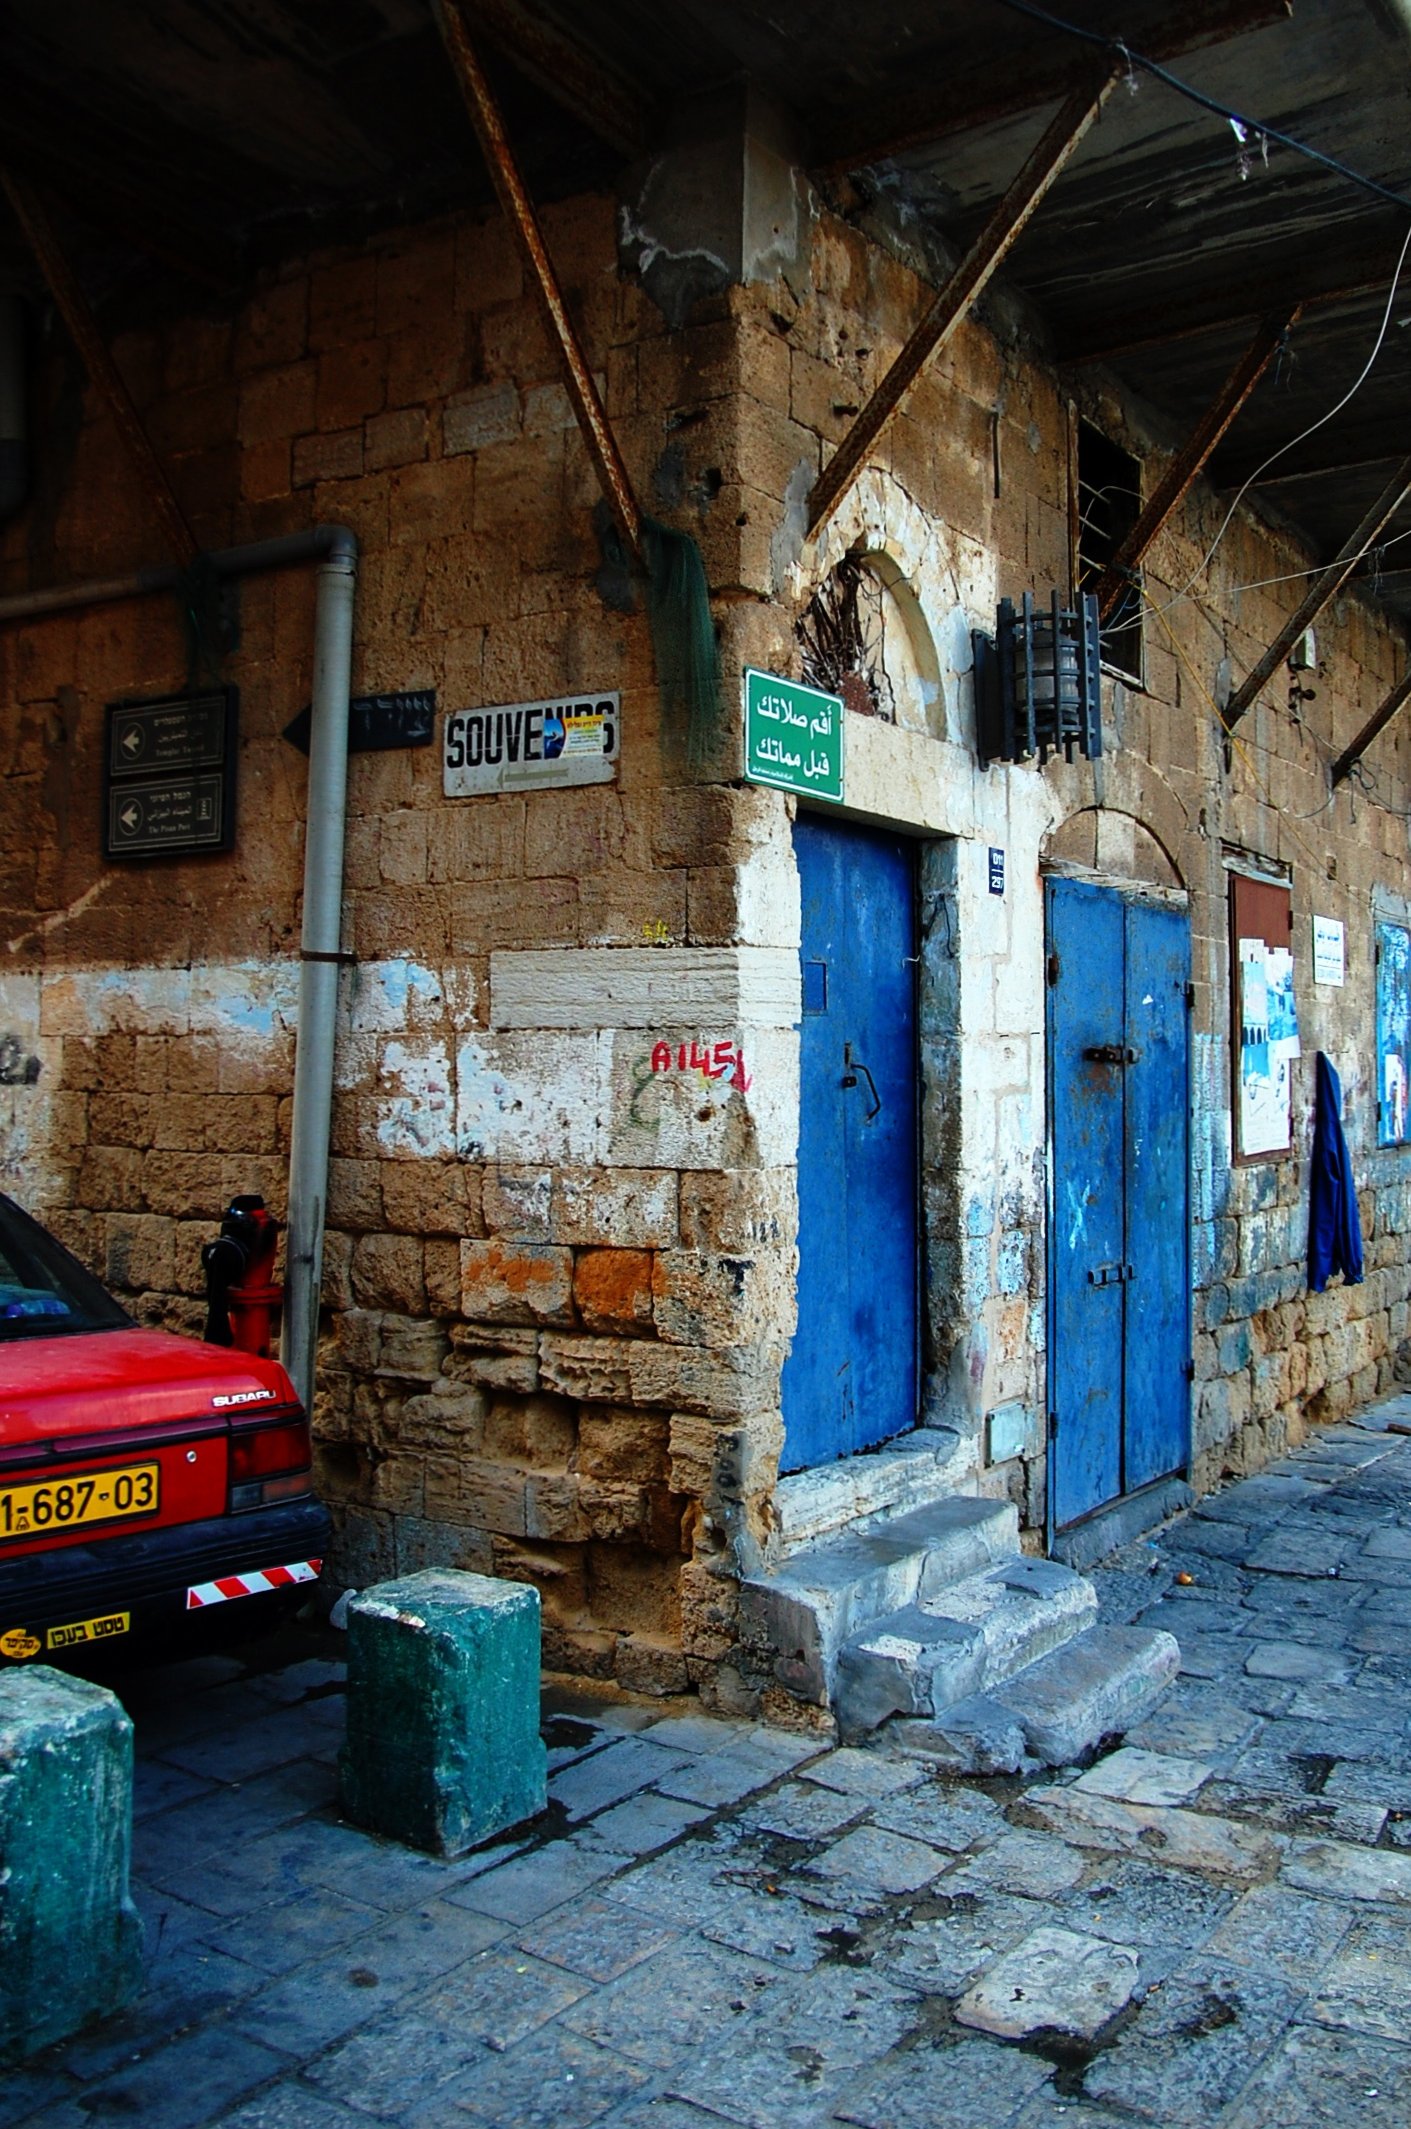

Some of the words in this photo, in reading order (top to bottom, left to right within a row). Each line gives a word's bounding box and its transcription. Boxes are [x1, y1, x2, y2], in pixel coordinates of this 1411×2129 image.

[757, 695, 809, 728] صلاتك
[810, 705, 832, 740] أقم
[447, 701, 615, 768] SOUVES
[756, 737, 801, 767] مماتك
[803, 750, 830, 780] قبل
[213, 1390, 276, 1407] SUBARU
[93, 1617, 125, 1637] טסט
